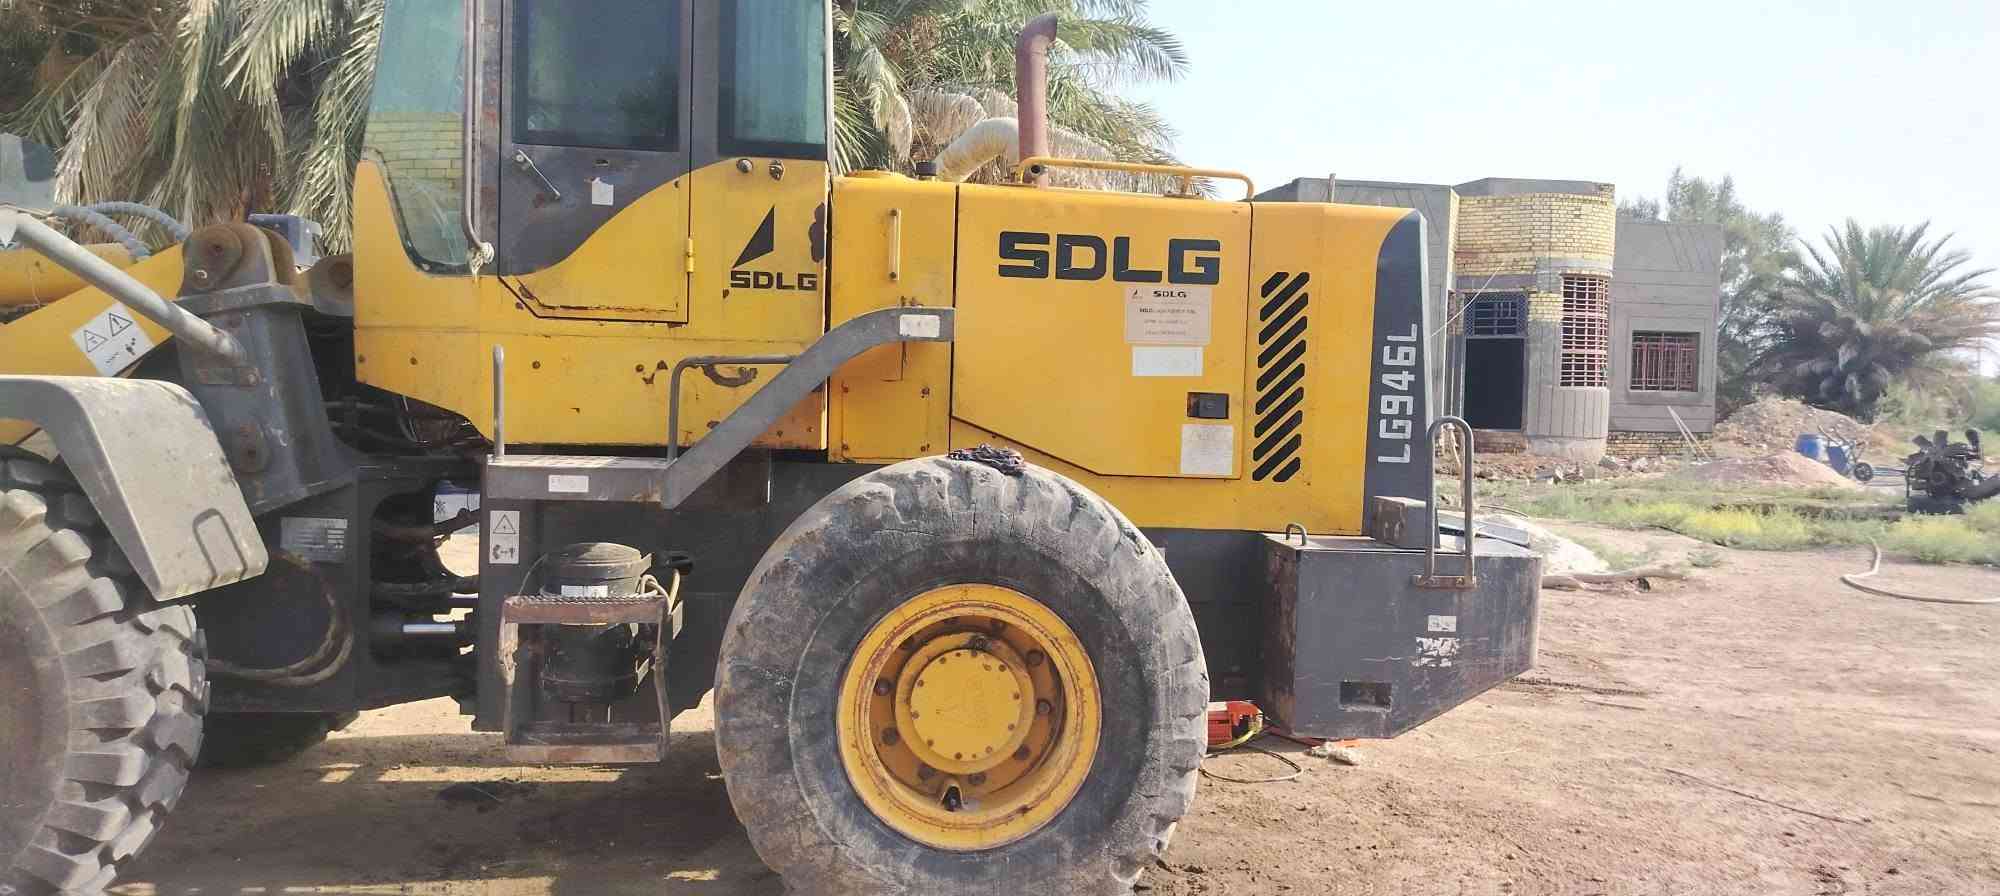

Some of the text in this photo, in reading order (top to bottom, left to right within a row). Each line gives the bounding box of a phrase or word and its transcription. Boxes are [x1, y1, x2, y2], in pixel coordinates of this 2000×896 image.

[998, 231, 1221, 285] SDLG
[730, 270, 818, 291] SDLG
[1152, 290, 1187, 298] SDLG
[1377, 323, 1418, 464] LG946L
